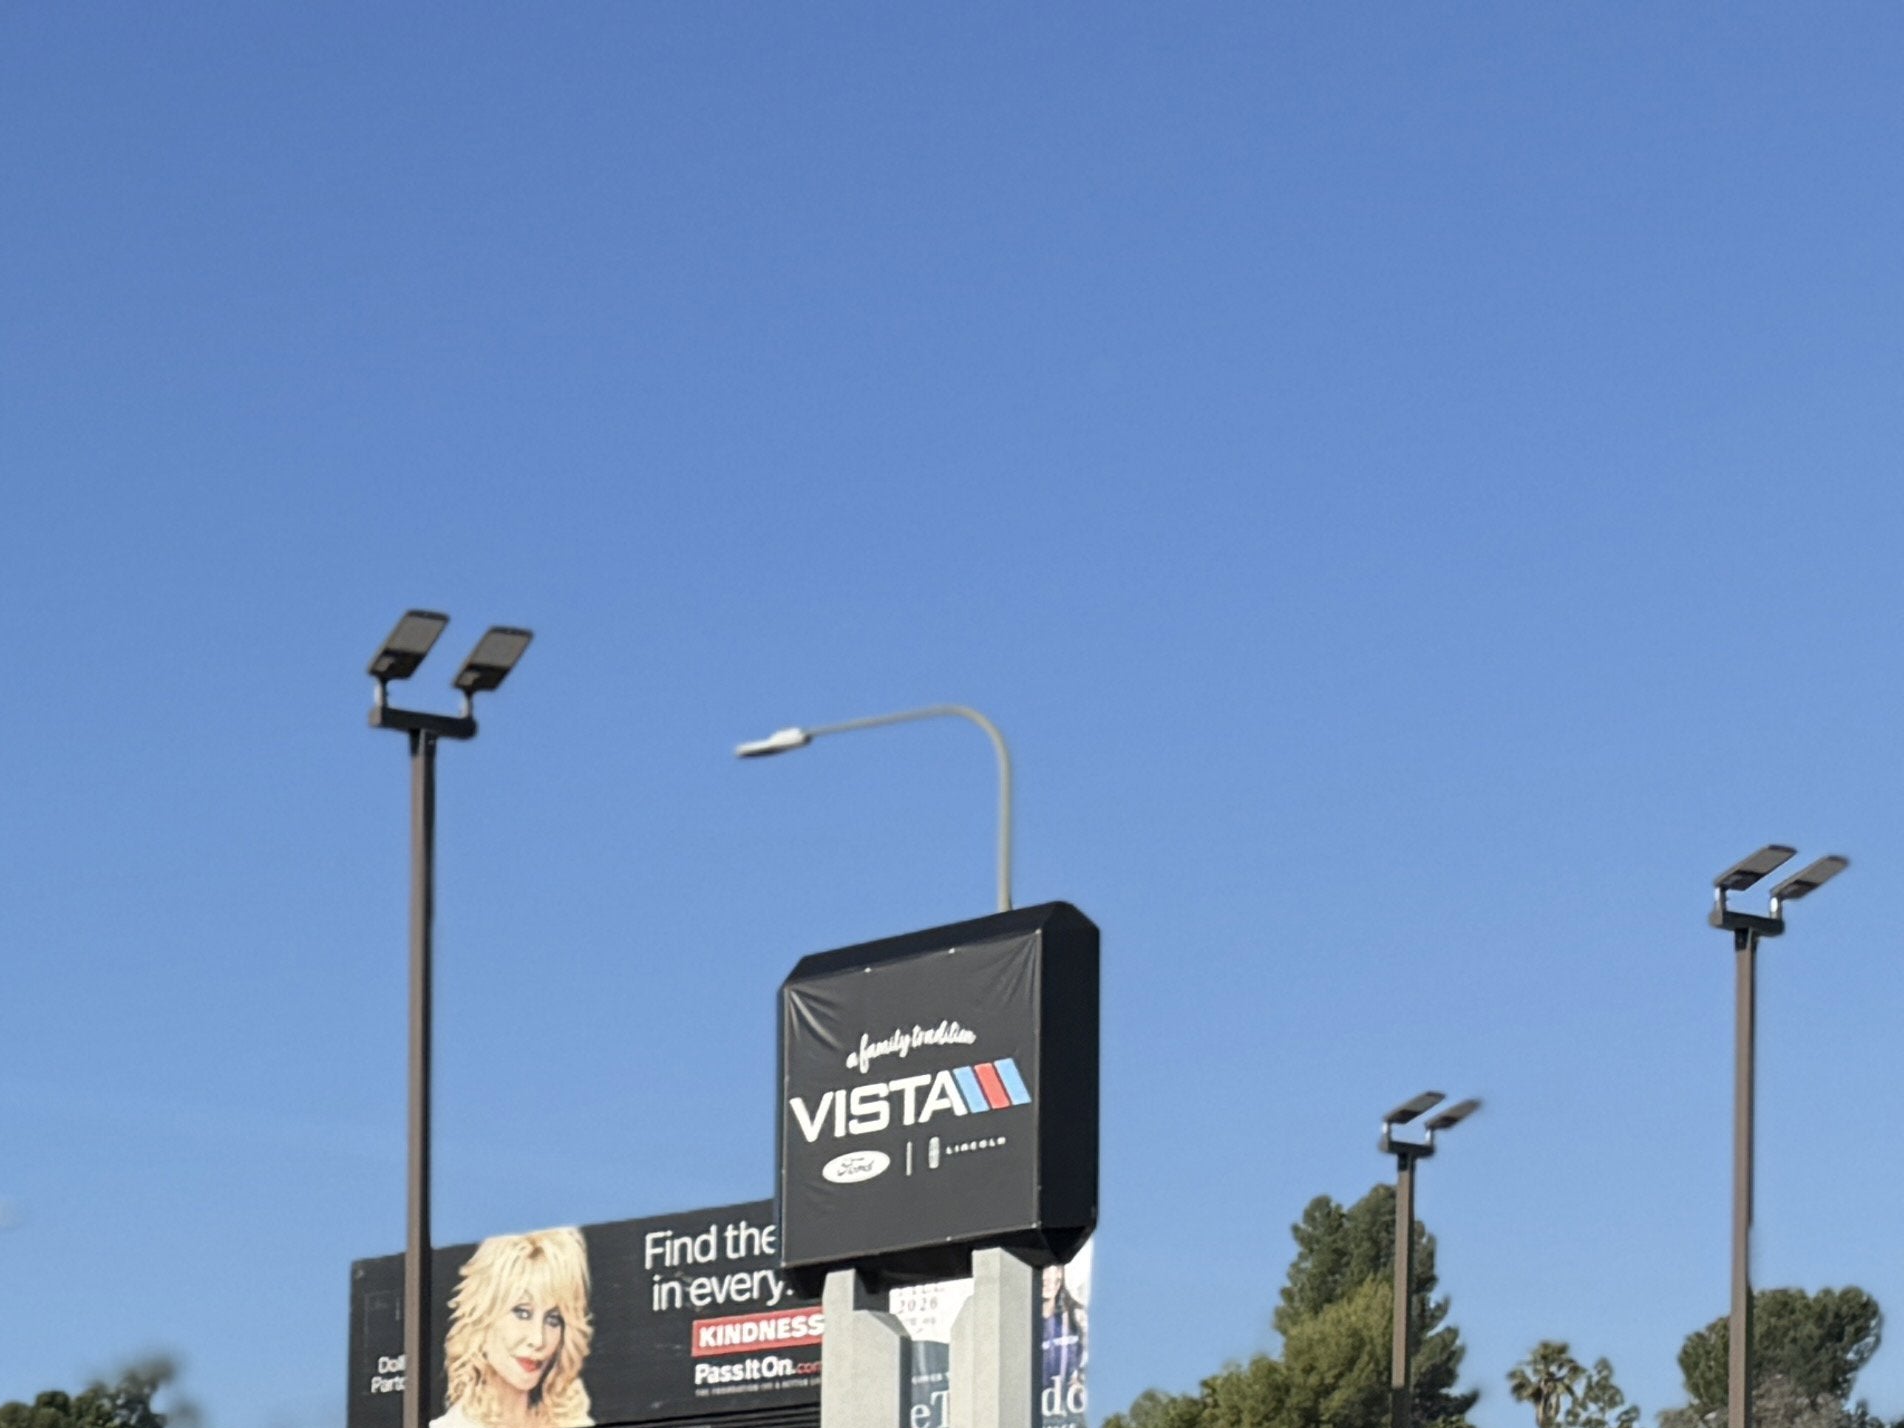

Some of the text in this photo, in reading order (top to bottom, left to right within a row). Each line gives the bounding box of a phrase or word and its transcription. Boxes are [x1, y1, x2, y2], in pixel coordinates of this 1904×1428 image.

[859, 1033, 911, 1074] family
[912, 1020, 977, 1048] tradition
[789, 1070, 968, 1143] VISTA
[645, 1224, 718, 1270] Find
[652, 1274, 682, 1311] in
[699, 1314, 824, 1347] KINDNESS
